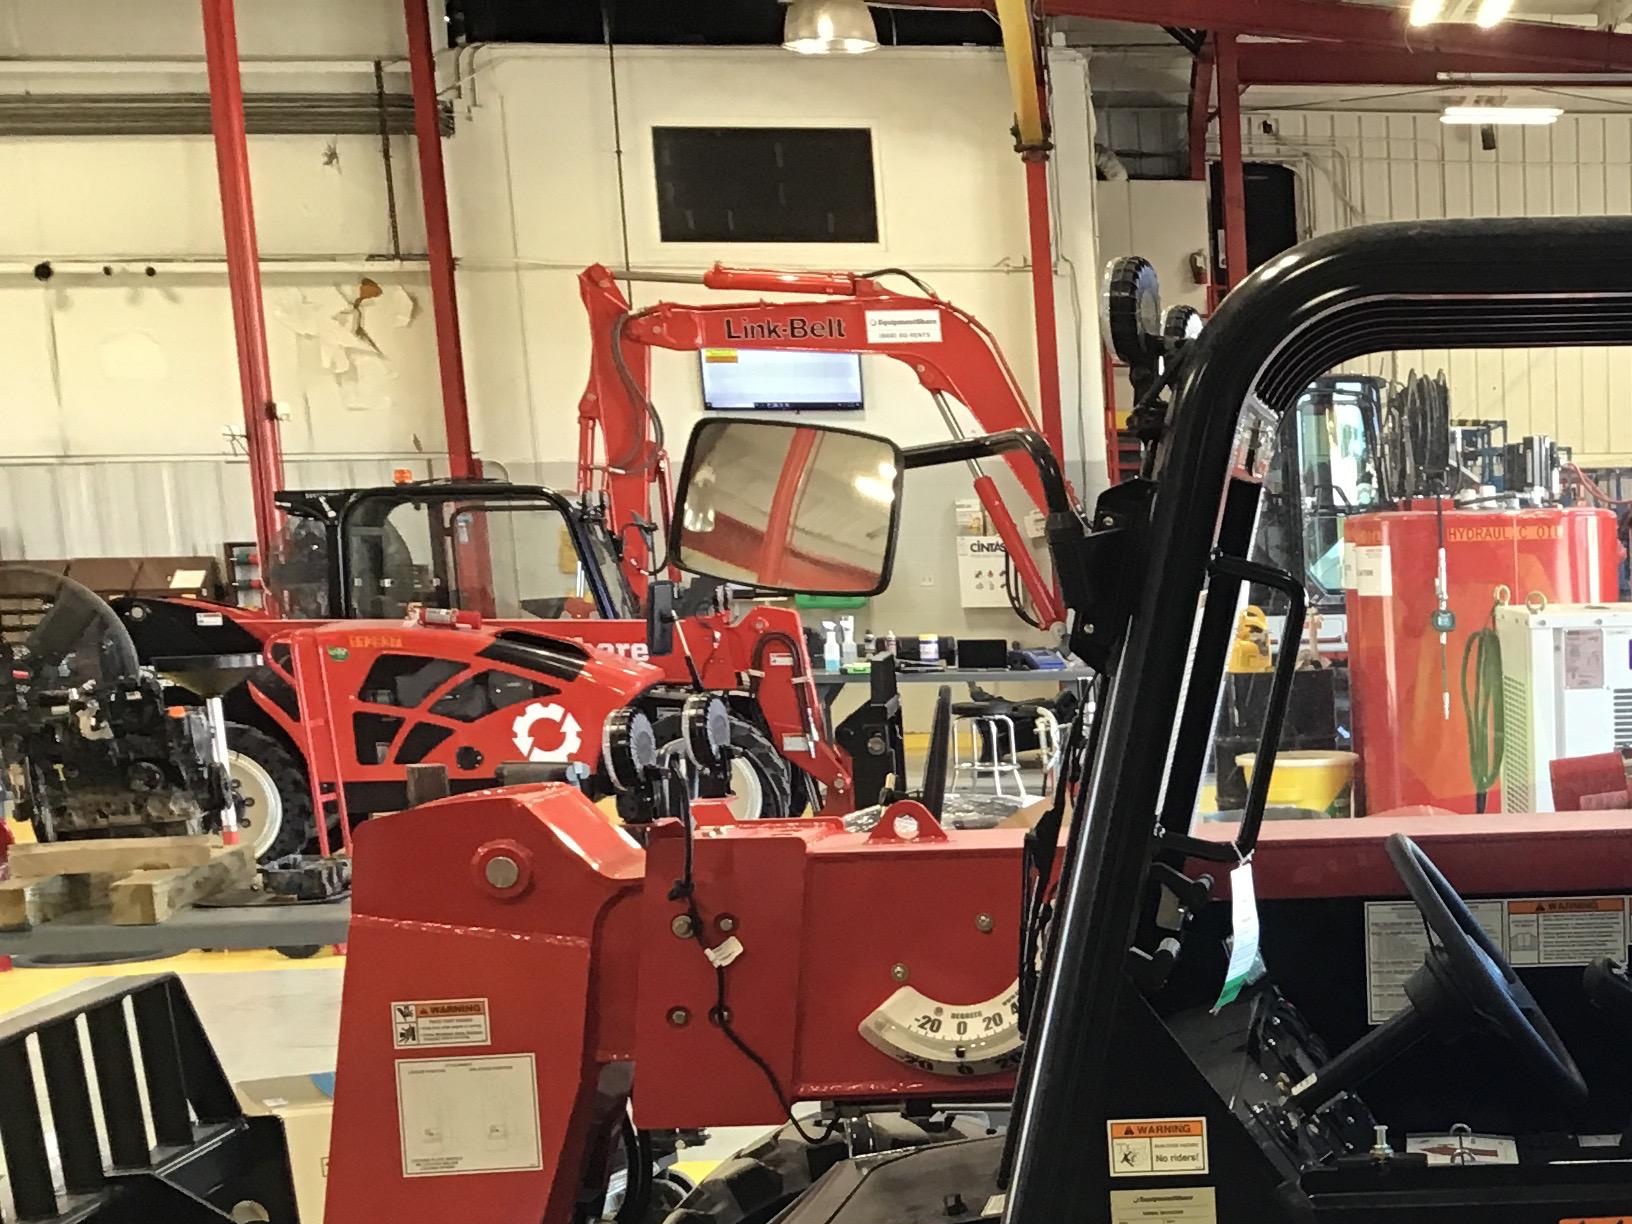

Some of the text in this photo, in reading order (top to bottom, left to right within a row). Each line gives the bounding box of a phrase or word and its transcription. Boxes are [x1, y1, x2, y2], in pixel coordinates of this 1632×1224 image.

[725, 317, 846, 340] Link-Belt
[430, 1004, 481, 1014] WARNING
[913, 1015, 943, 1033] -20
[956, 1021, 968, 1035] 0
[982, 1012, 1004, 1031] 20
[1136, 1123, 1191, 1135] WARNING
[1155, 1153, 1200, 1163] No riders!
